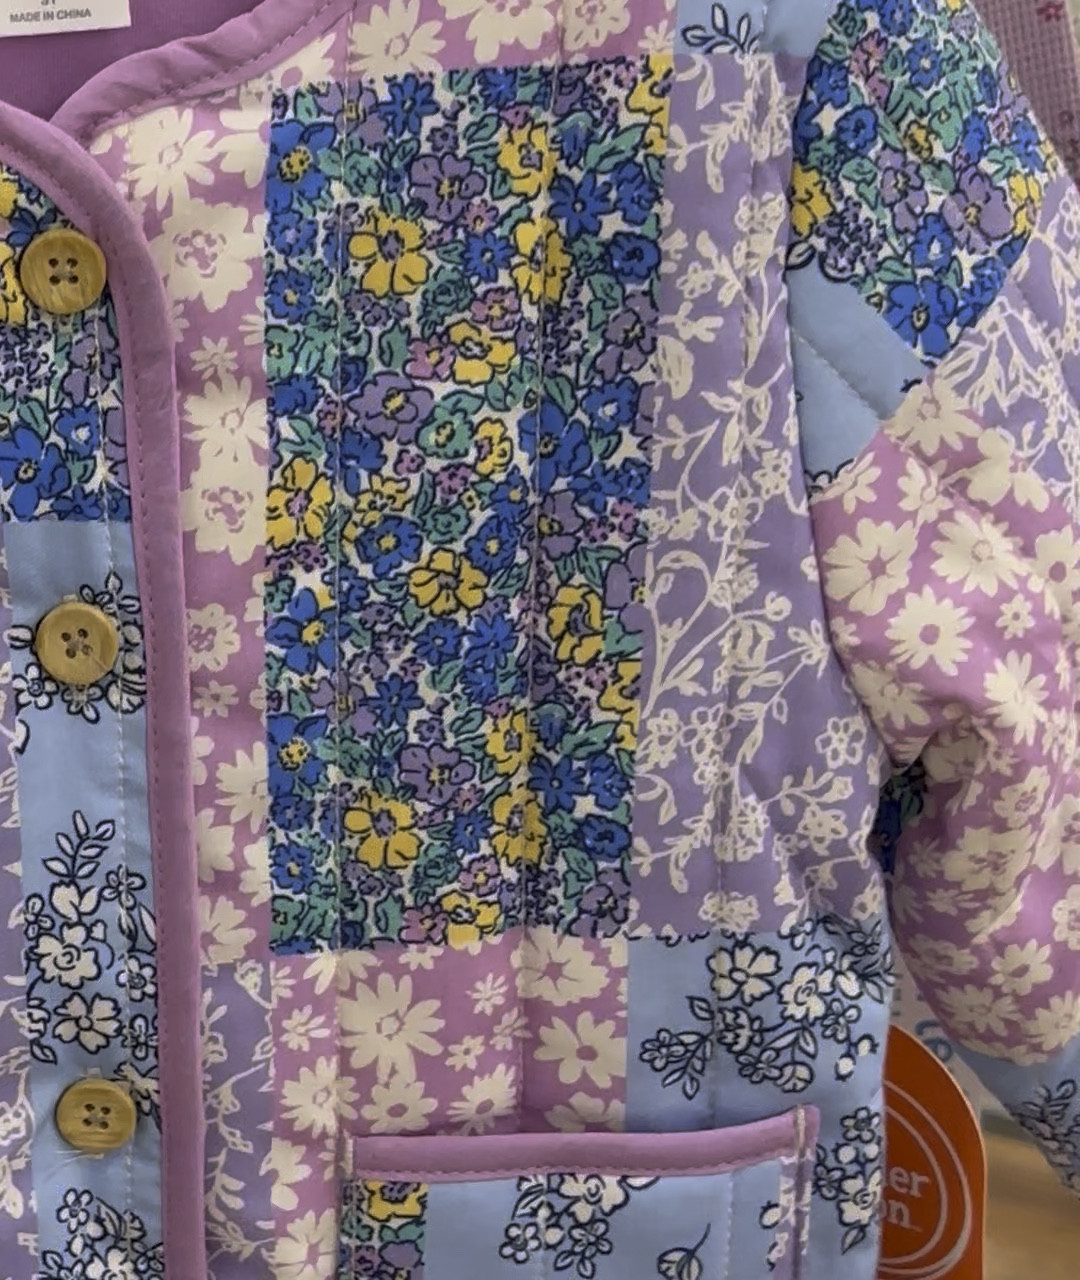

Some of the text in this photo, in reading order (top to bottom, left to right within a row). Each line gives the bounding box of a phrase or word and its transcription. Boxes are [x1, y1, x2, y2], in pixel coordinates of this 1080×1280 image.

[10, 8, 92, 23] MADE IN CHINA
